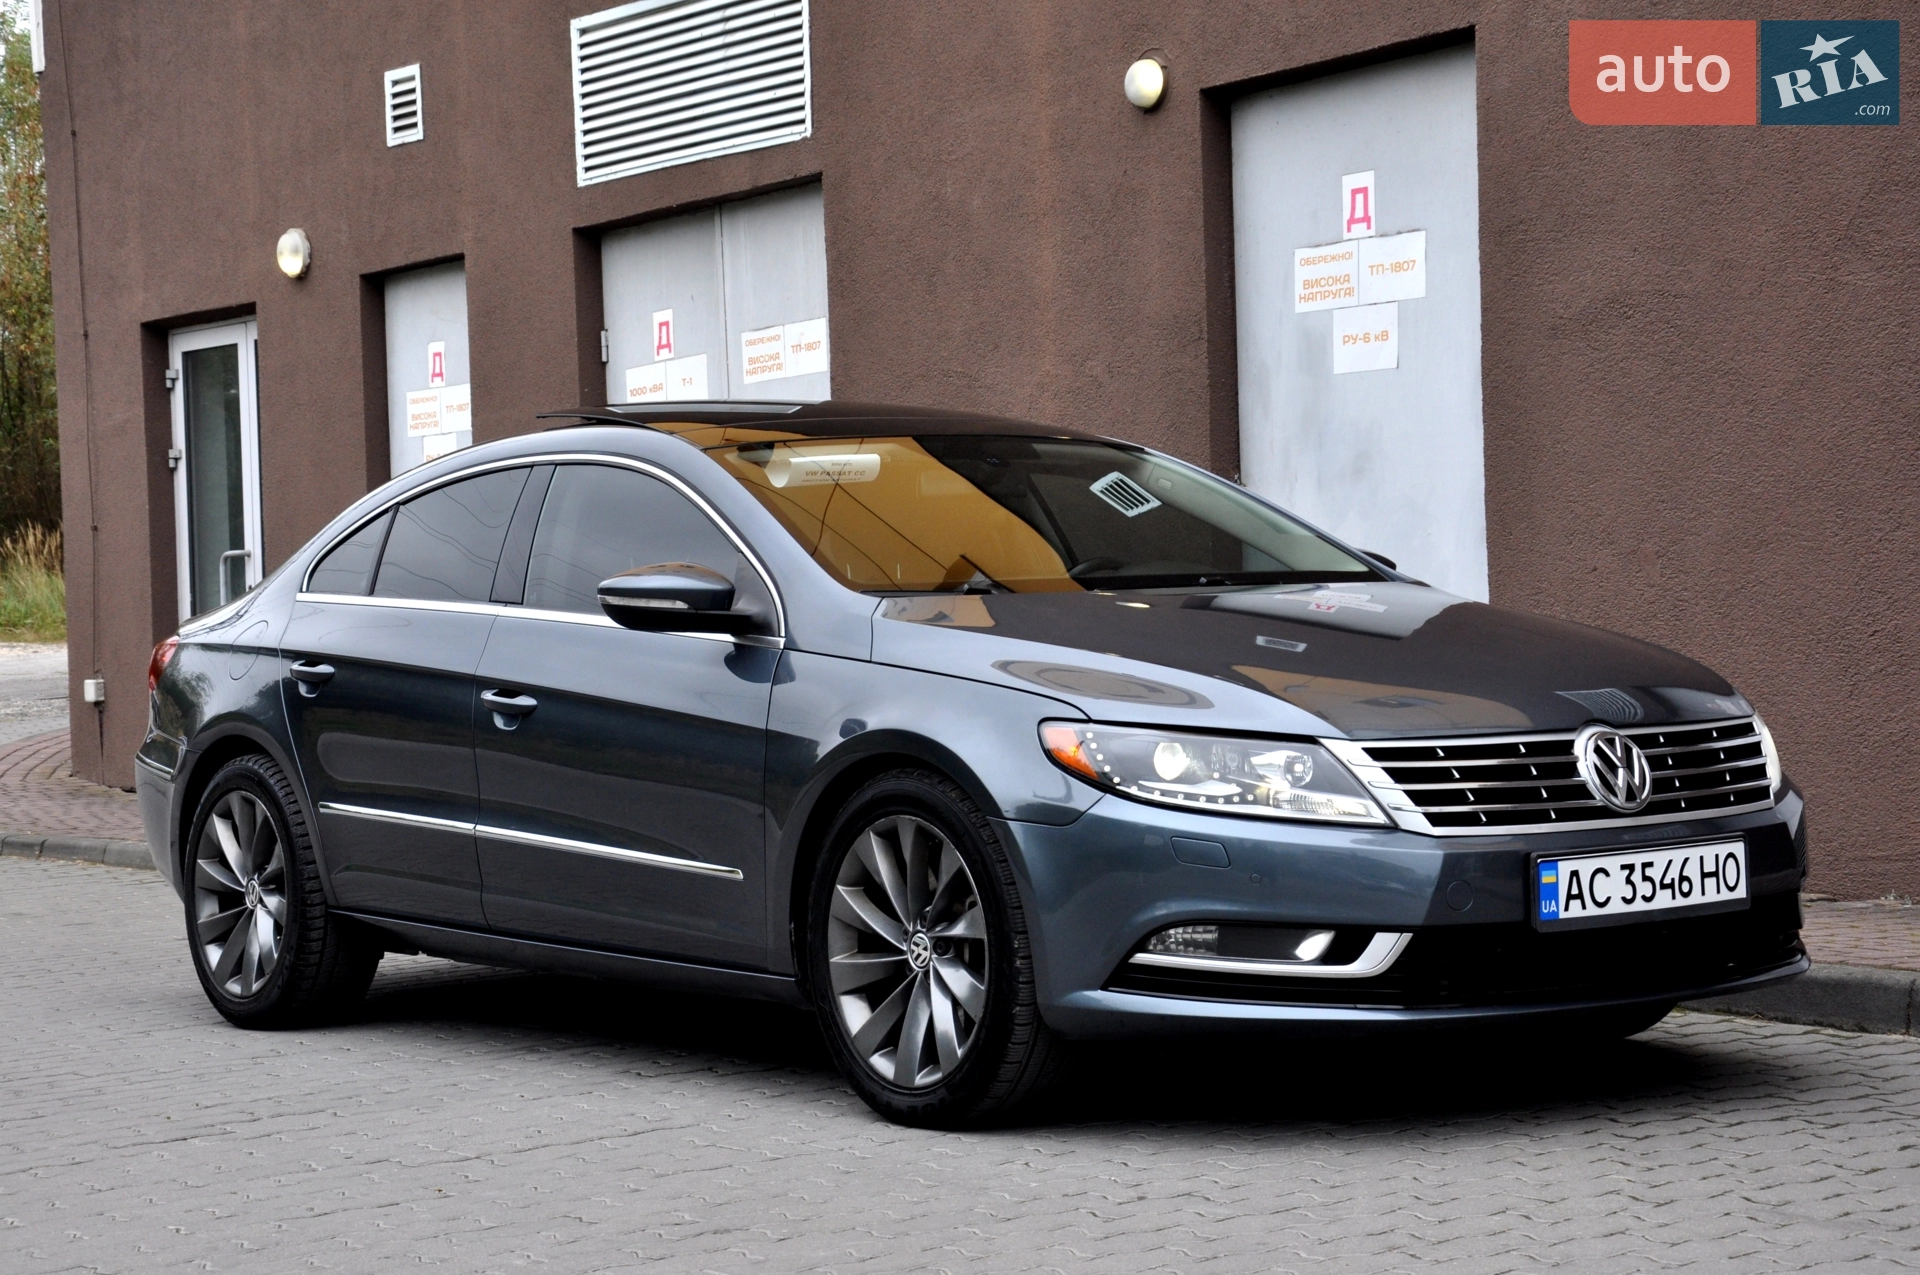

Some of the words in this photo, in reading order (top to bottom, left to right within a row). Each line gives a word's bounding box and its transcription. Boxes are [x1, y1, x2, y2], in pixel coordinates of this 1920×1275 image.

[1346, 186, 1372, 233] Д
[1299, 251, 1354, 267] ОБЕРЕЖНО!
[1368, 259, 1417, 276] ТП-1807
[1302, 273, 1351, 290] ВИСОКА
[1298, 286, 1355, 304] НАПРУГА!
[656, 320, 672, 356] Д
[744, 334, 782, 347] ОБЕРЕЖНО!
[1342, 332, 1371, 346] РУ-6
[1374, 330, 1390, 343] кВ
[790, 340, 822, 355] ТП-1807
[747, 351, 781, 366] ВИСОКА
[431, 351, 444, 383] Д
[745, 362, 784, 377] НАПРУГА!
[629, 385, 647, 398] 1000
[648, 382, 664, 394] кВА
[681, 377, 693, 387] Т-1
[411, 411, 437, 421] ВИСОКА
[445, 402, 470, 414] ТП-1807
[409, 420, 439, 430] НАПРУГА!
[1563, 866, 1612, 913] AC
[1619, 857, 1694, 905] 3546
[1699, 851, 1741, 897] HO
[1541, 899, 1558, 914] UA
